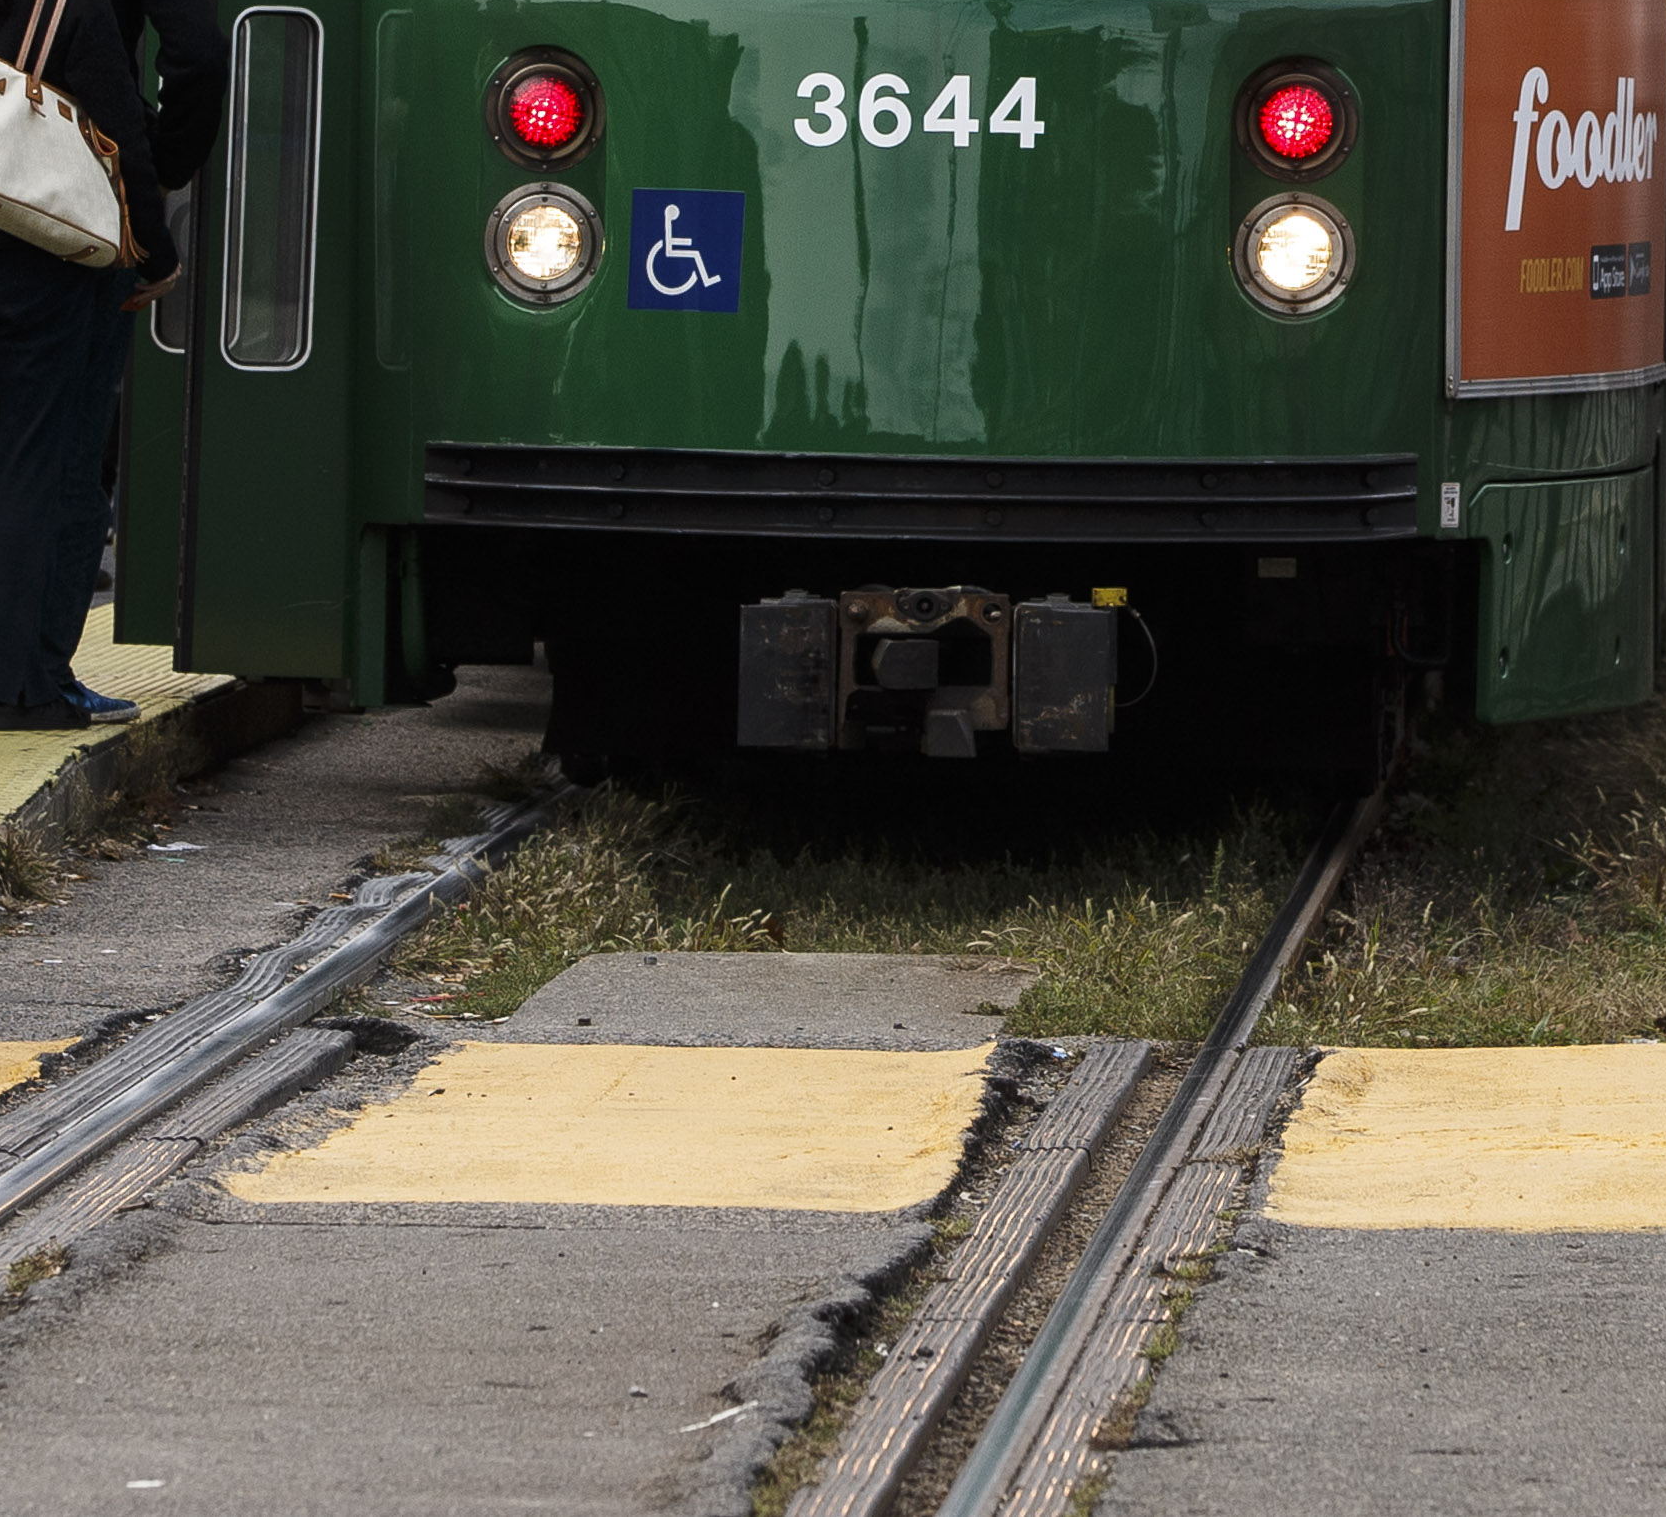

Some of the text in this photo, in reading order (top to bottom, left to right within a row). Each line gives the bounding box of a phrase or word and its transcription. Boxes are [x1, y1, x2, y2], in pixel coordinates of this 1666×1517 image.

[793, 72, 1045, 149] 3644
[1504, 66, 1657, 232] foodler
[1520, 256, 1584, 293] FOODLER.COM
